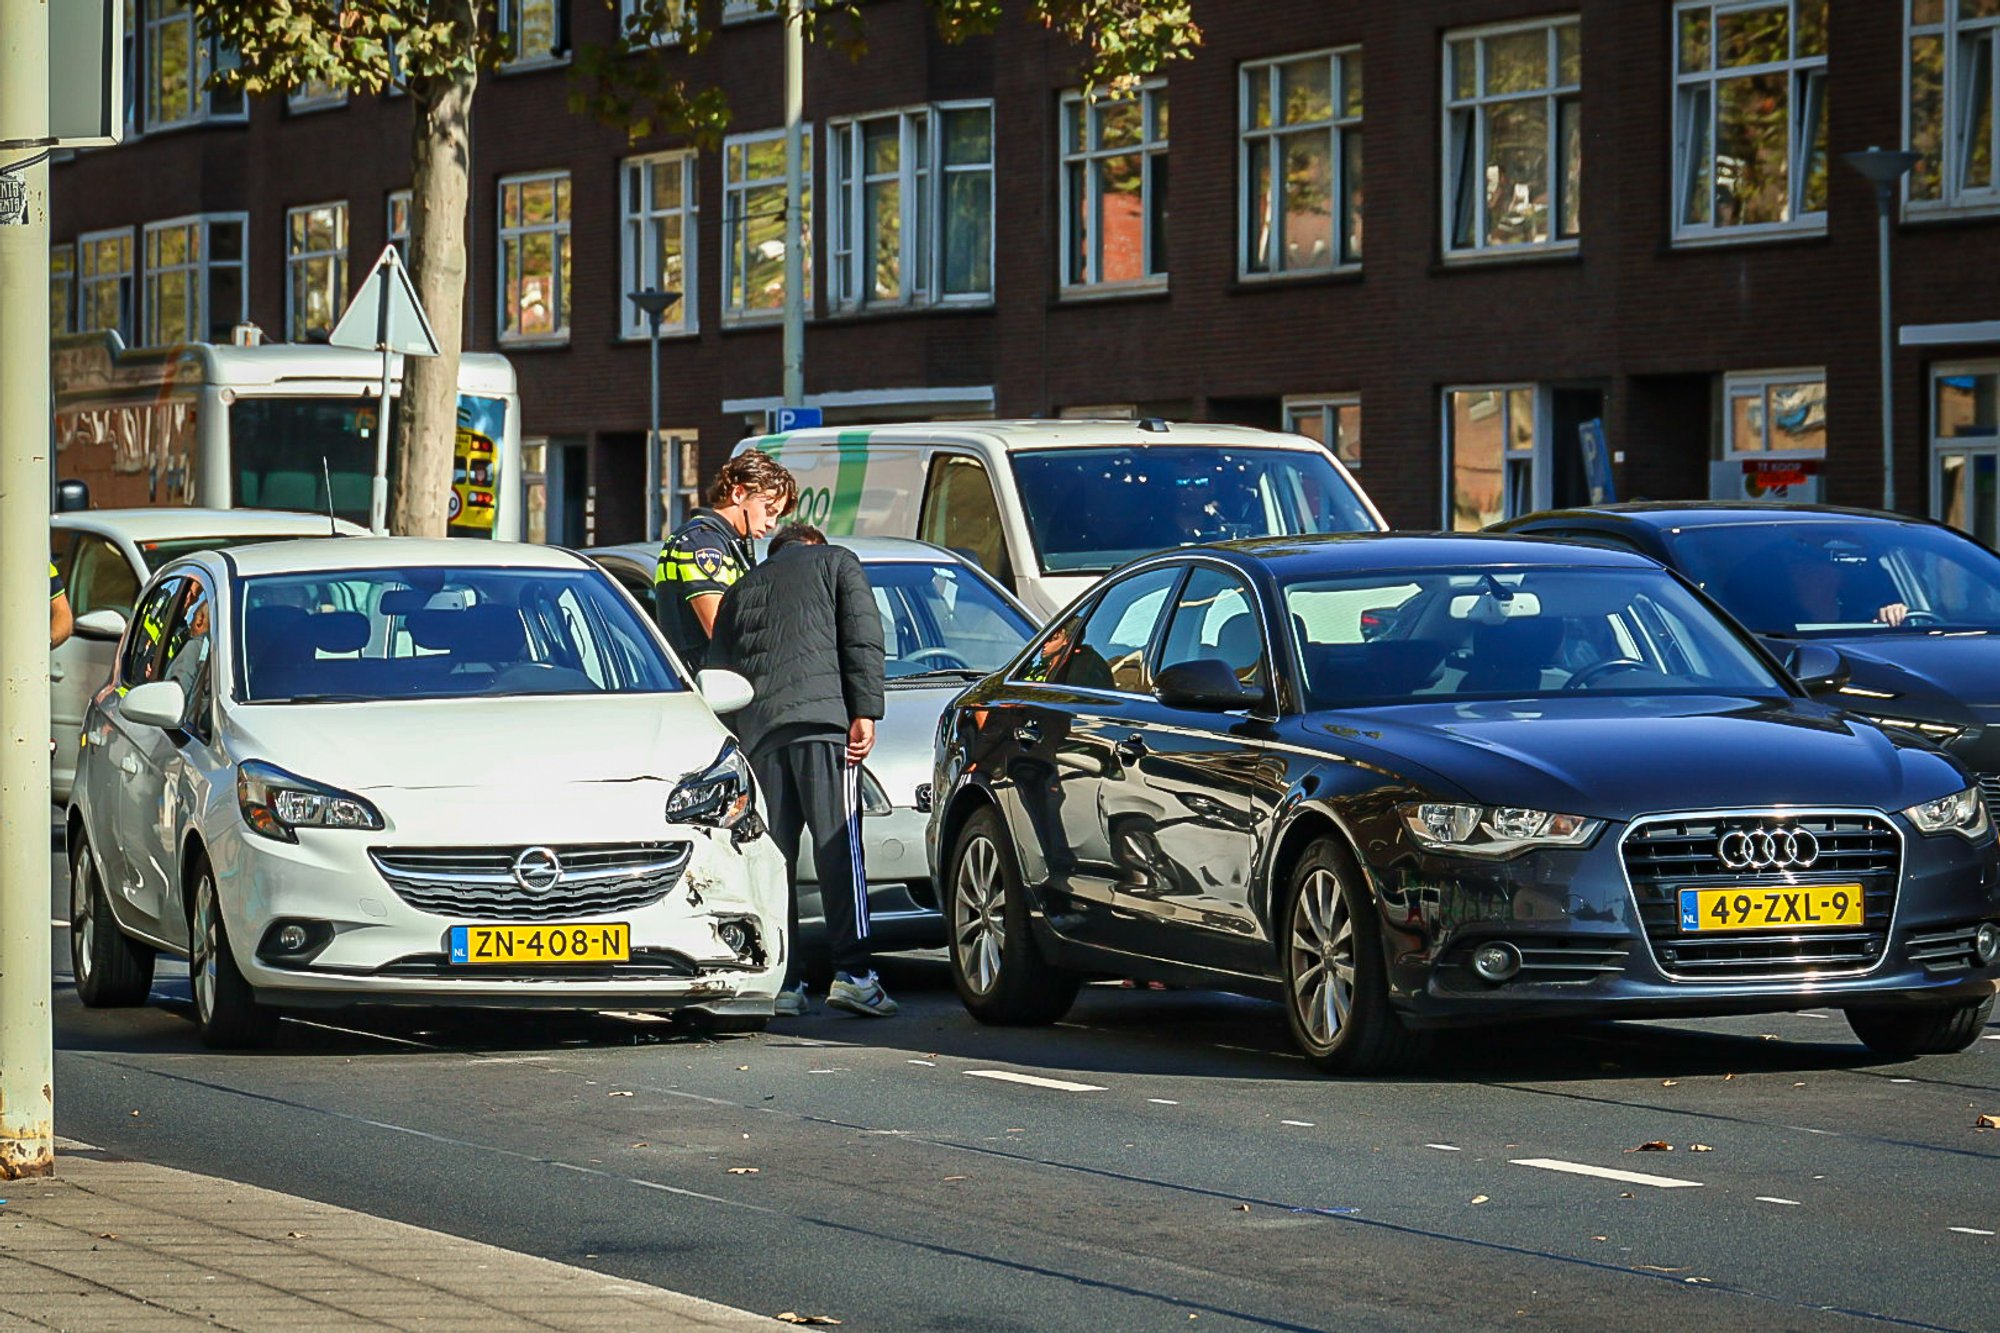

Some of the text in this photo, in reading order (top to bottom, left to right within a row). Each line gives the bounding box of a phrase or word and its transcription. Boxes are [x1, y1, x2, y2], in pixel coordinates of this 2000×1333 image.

[780, 410, 796, 432] P
[1683, 891, 1849, 924] NL 49-ZXL-9
[454, 929, 620, 957] NL ZN-408-N
